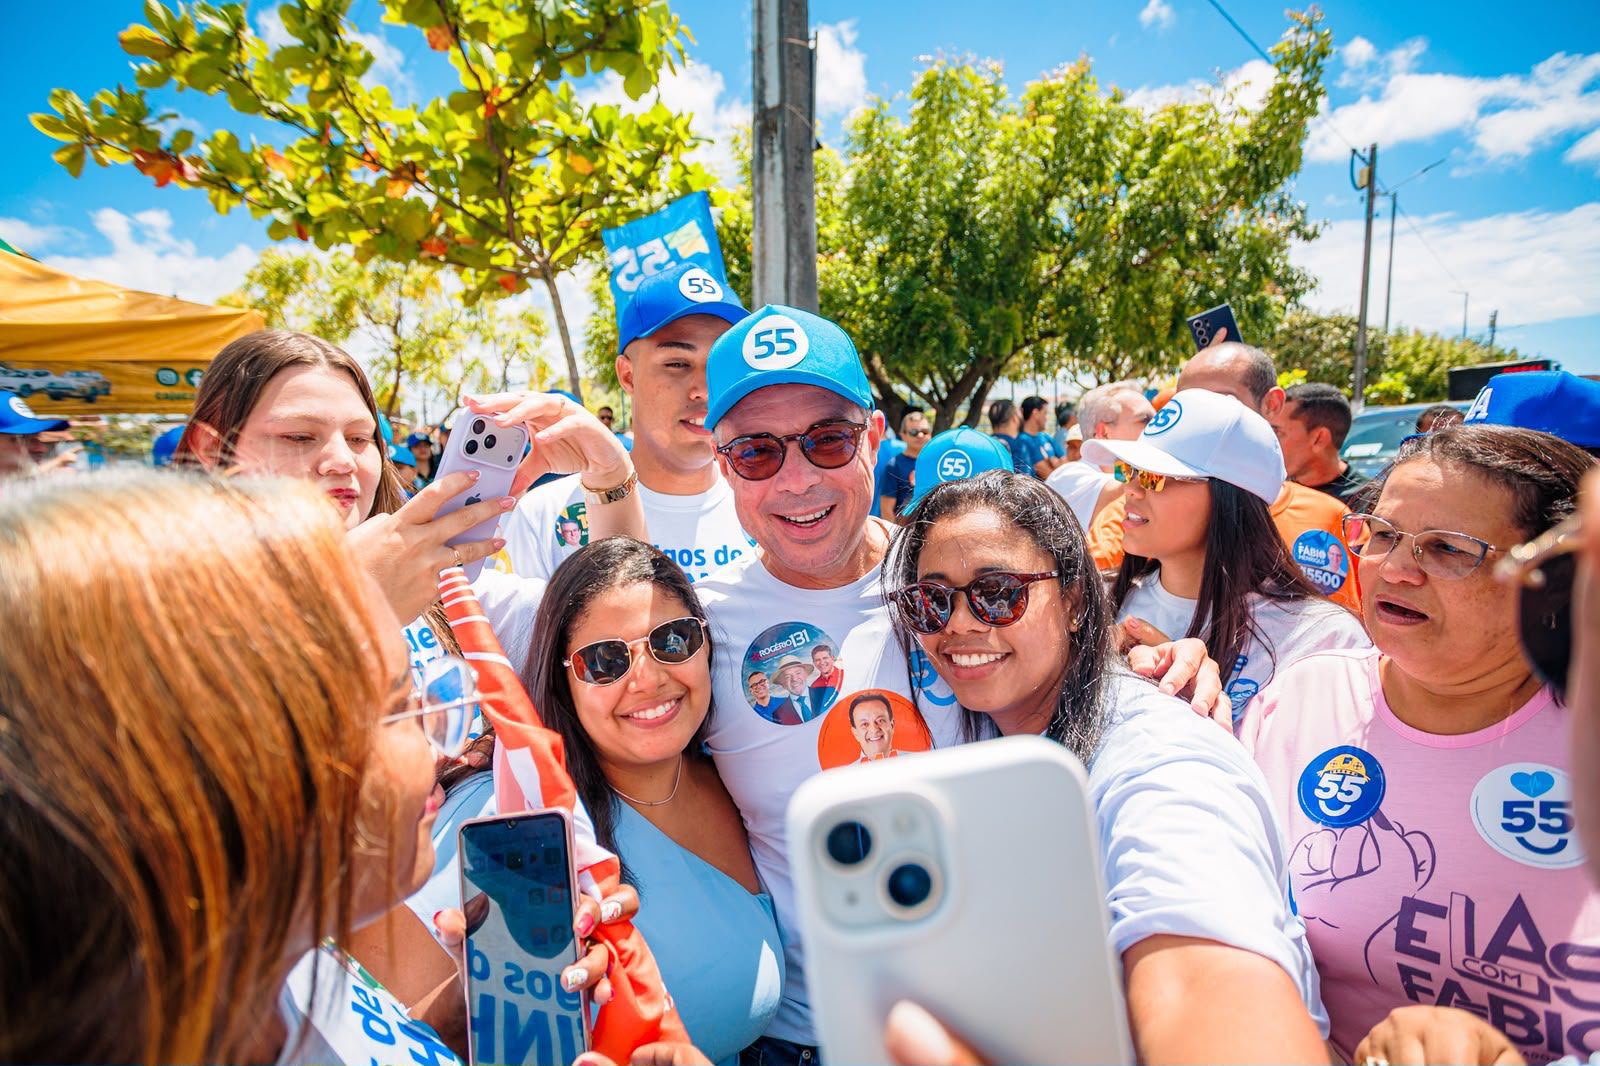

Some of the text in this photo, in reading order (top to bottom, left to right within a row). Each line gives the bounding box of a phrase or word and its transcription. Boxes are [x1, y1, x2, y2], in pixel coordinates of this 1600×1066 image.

[688, 277, 716, 294] 55
[754, 328, 797, 360] 55
[941, 457, 967, 477] 55
[789, 628, 811, 647] 131
[1314, 773, 1367, 803] 55
[1501, 801, 1575, 835] 55
[1462, 956, 1522, 989] COM
[352, 984, 396, 1046] de
